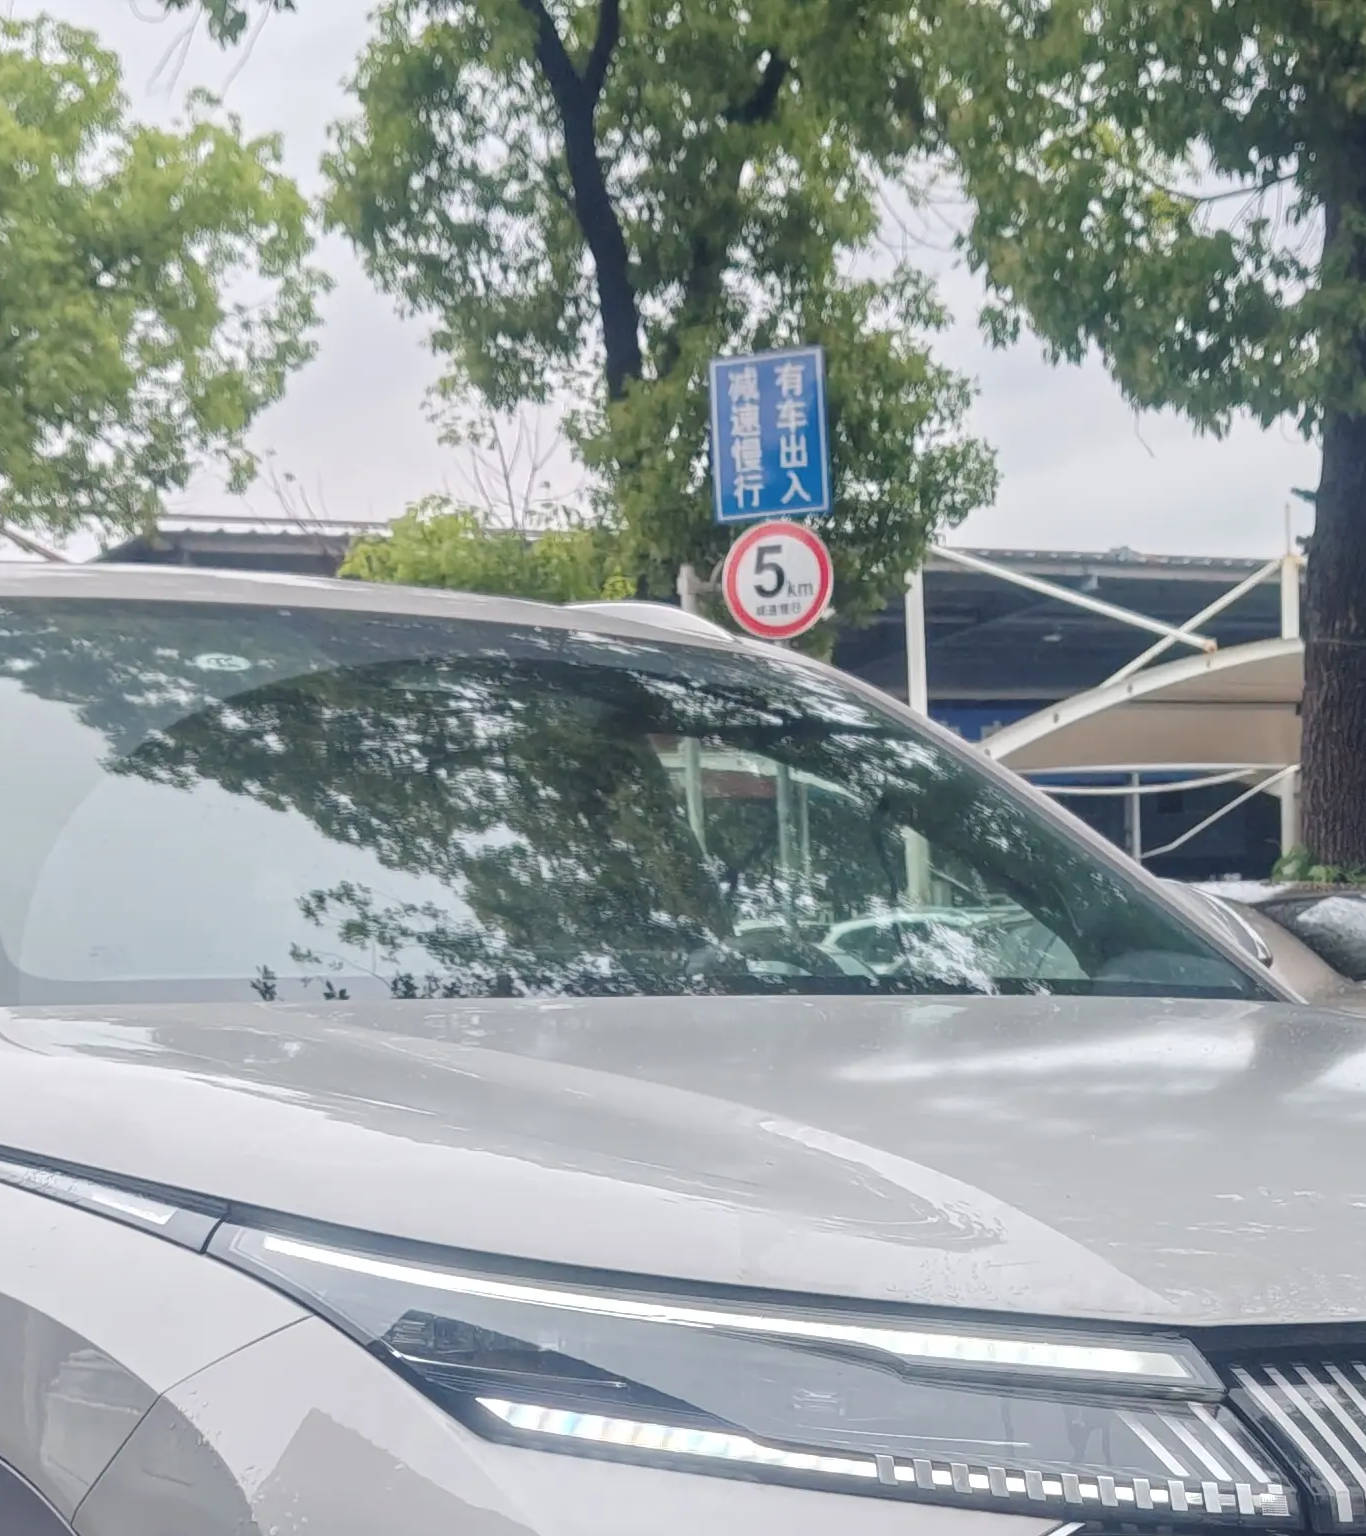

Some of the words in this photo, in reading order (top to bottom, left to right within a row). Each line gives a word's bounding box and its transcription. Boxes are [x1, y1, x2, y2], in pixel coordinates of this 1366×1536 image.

[728, 365, 764, 509] 减速慢行
[774, 361, 812, 504] 有车出入
